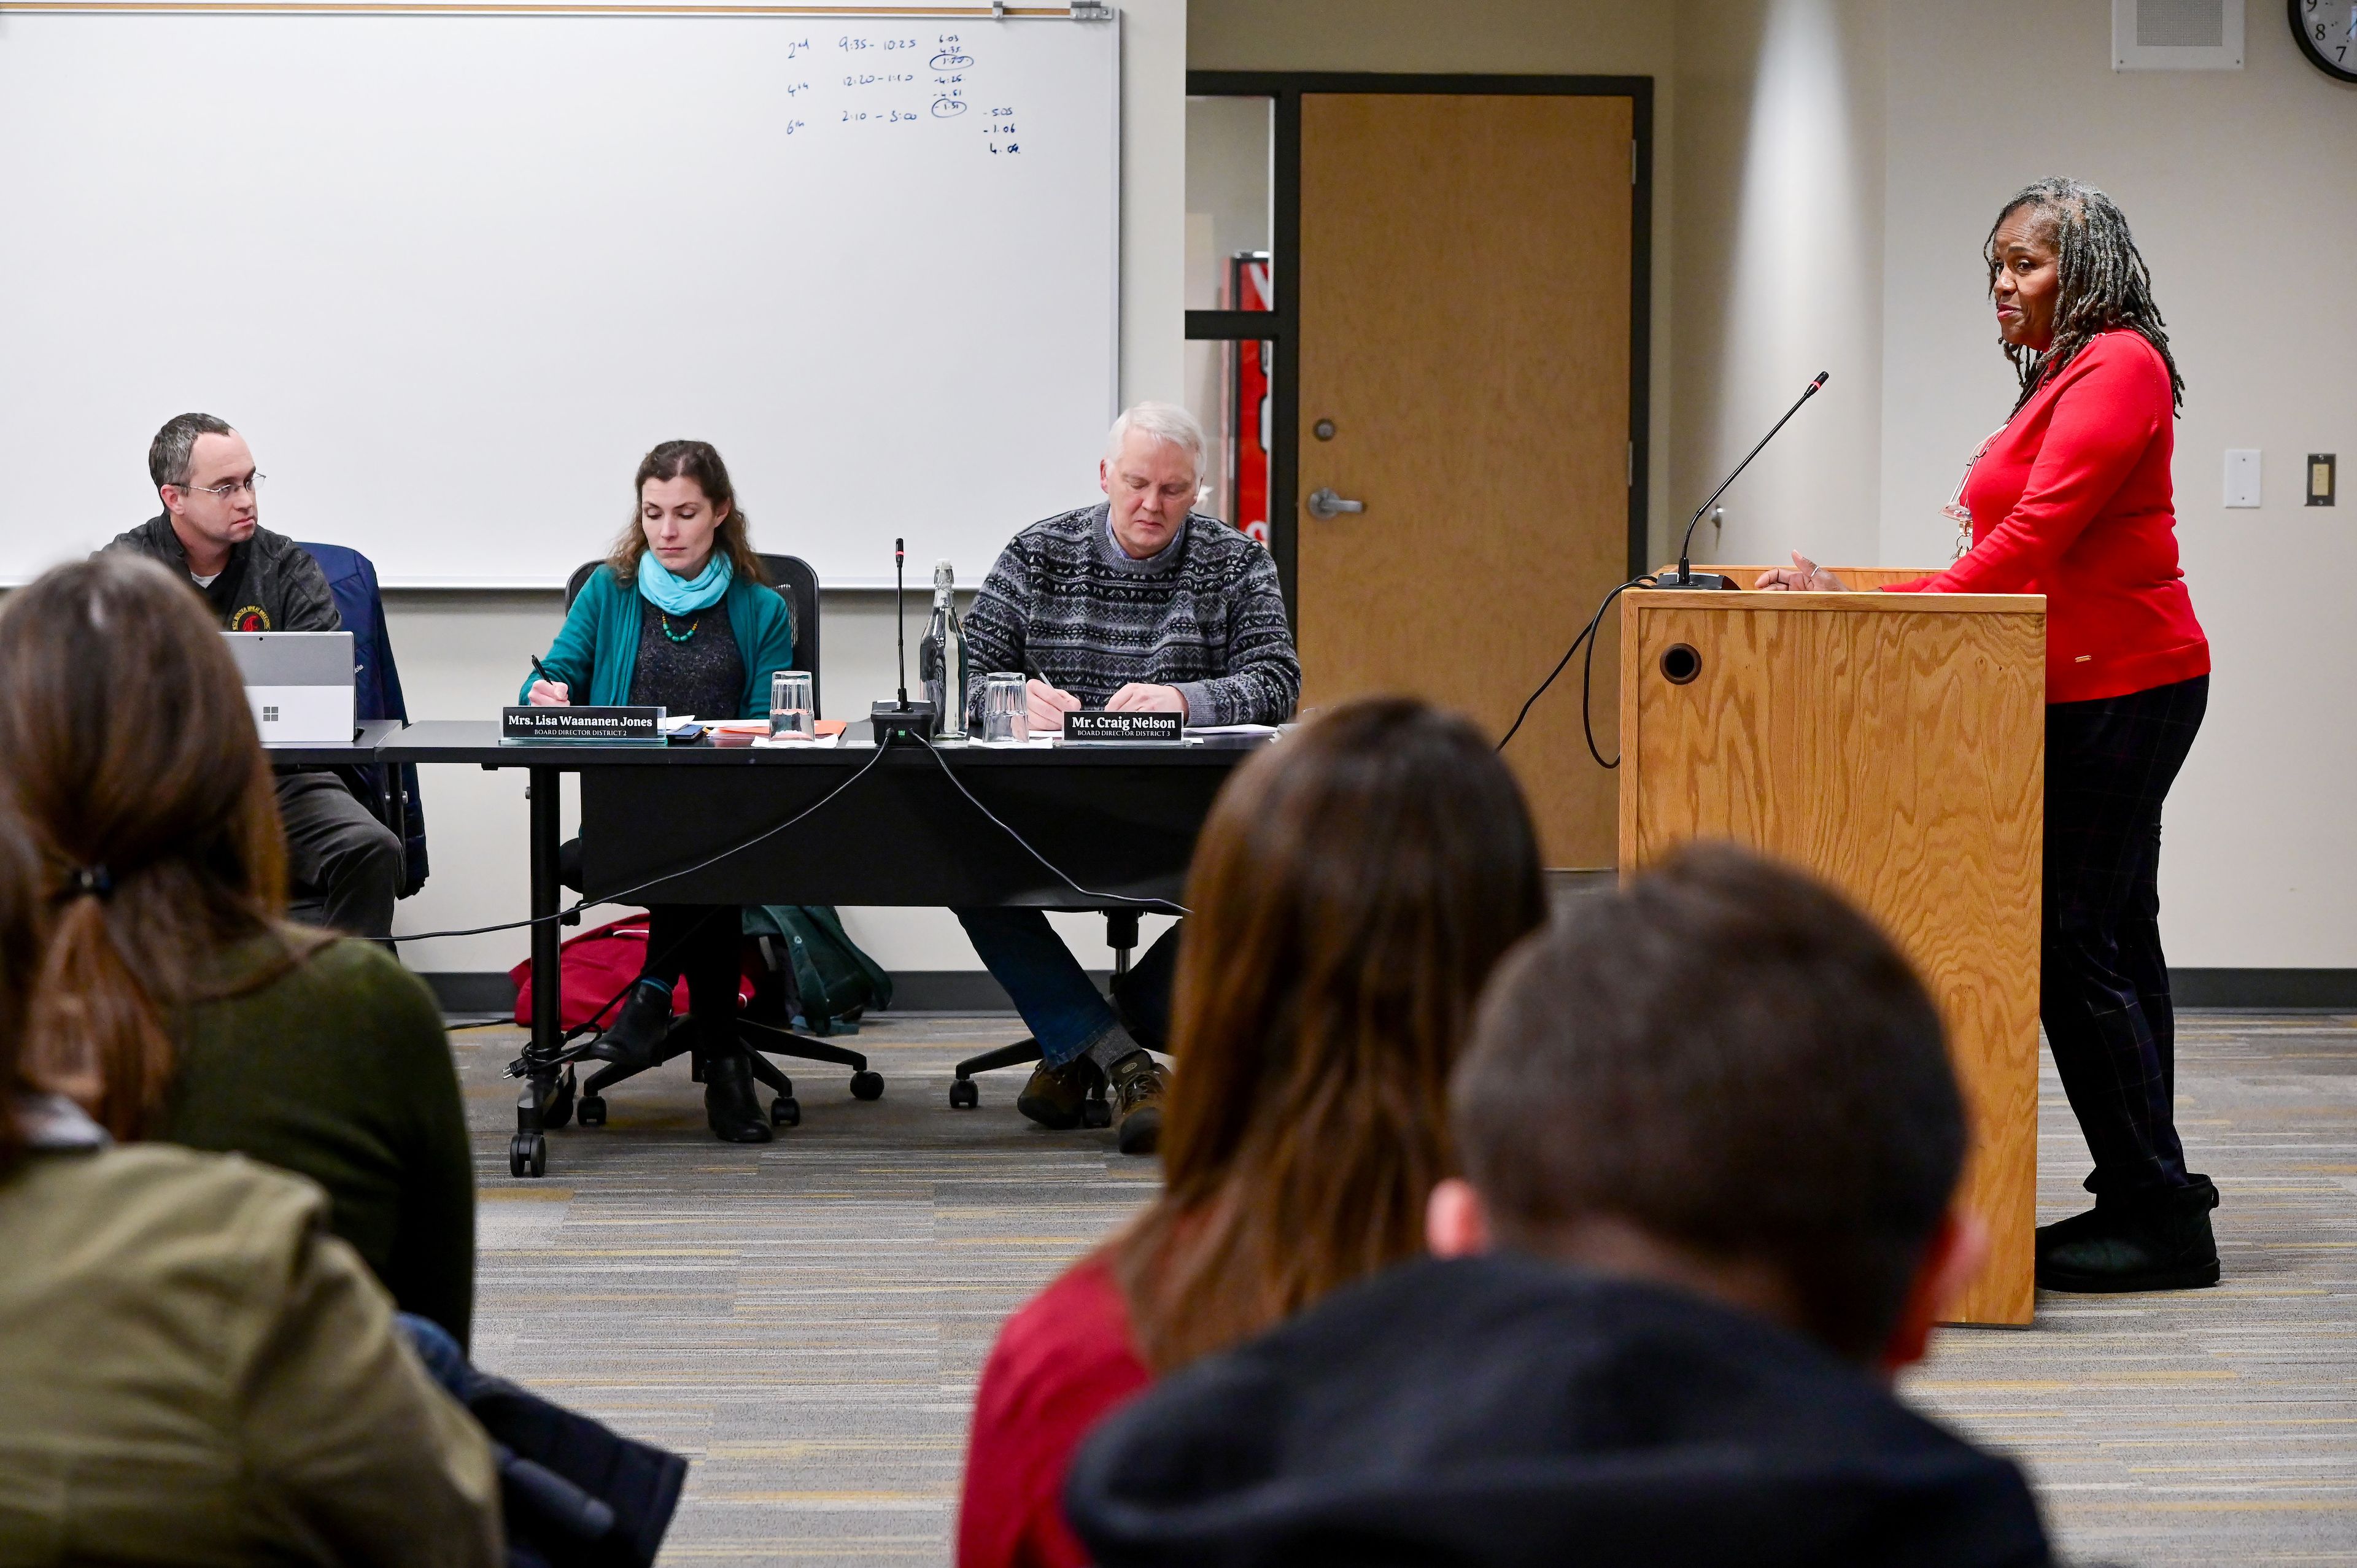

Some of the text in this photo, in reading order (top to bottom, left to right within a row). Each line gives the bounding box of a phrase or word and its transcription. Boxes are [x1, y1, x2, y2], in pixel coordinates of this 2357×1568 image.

[2315, 23, 2325, 41] 8
[2336, 46, 2347, 62] 7
[508, 714, 652, 727] Mrs. Lisa Waananen Jones
[1072, 716, 1176, 730] Mr. Craig Nelson
